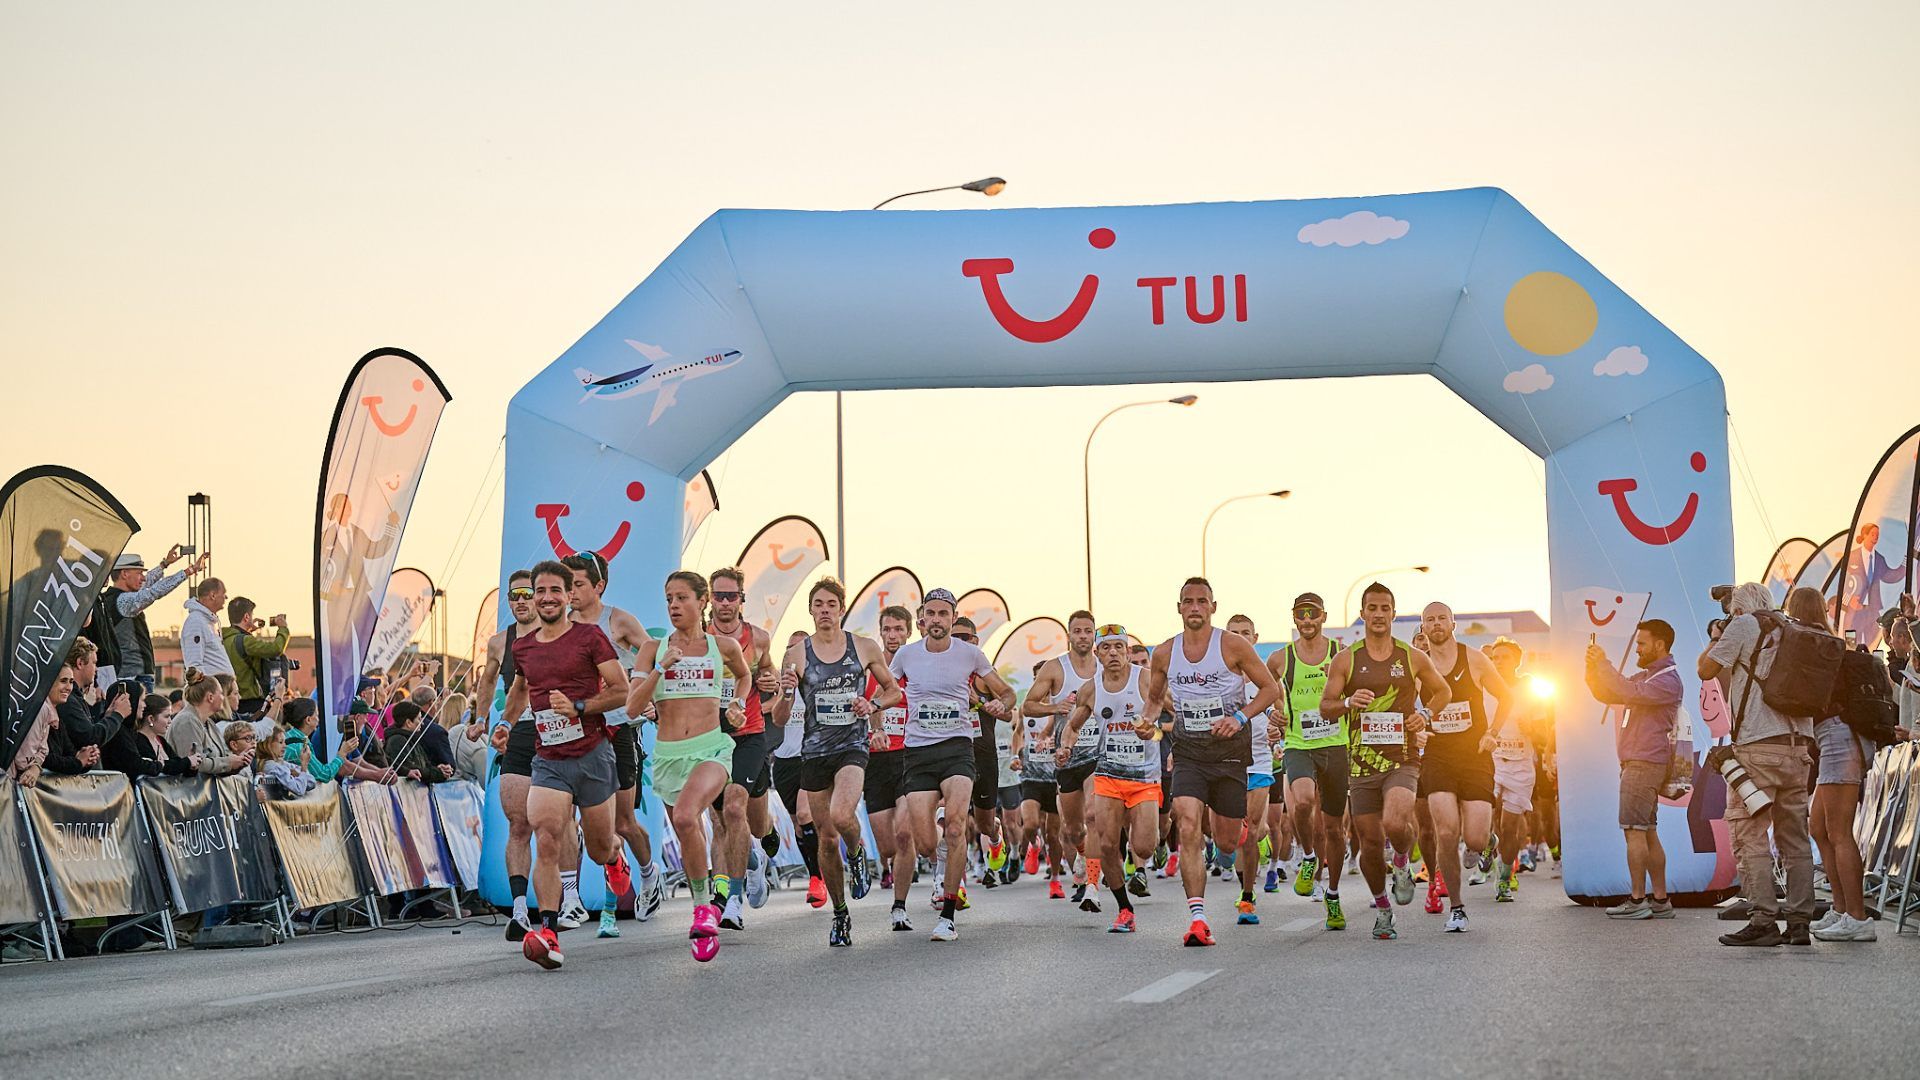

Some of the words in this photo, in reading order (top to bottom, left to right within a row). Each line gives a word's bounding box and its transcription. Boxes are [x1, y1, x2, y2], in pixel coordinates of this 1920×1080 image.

[1137, 274, 1248, 325] TUI
[704, 353, 723, 365] TUI
[673, 670, 705, 680] 3901
[830, 705, 844, 713] 45
[927, 712, 951, 720] 1377
[1192, 710, 1210, 719] 791
[1439, 713, 1461, 721] 4391
[543, 718, 572, 732] 3902
[1368, 723, 1395, 732] 6456
[53, 822, 99, 863] RUN
[173, 816, 226, 859] RUN
